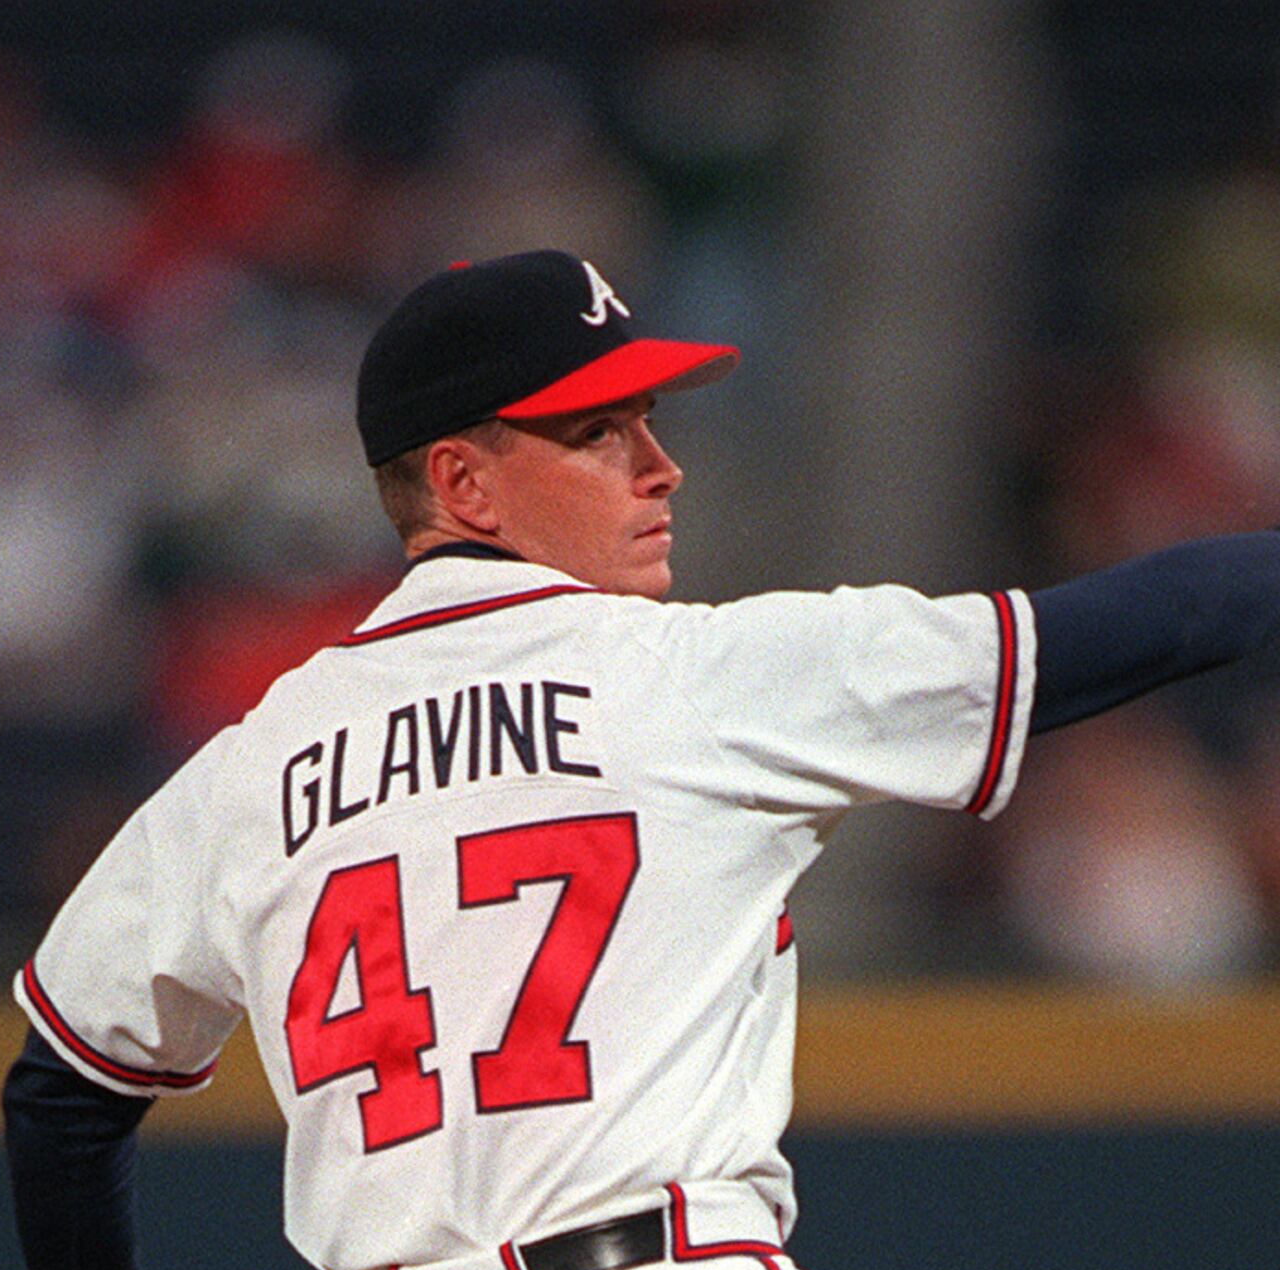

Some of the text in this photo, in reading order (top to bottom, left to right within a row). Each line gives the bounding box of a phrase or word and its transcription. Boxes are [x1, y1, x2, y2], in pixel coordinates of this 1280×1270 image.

[579, 260, 632, 326] A
[283, 681, 603, 858] GLAVINE
[284, 811, 641, 1154] 47
